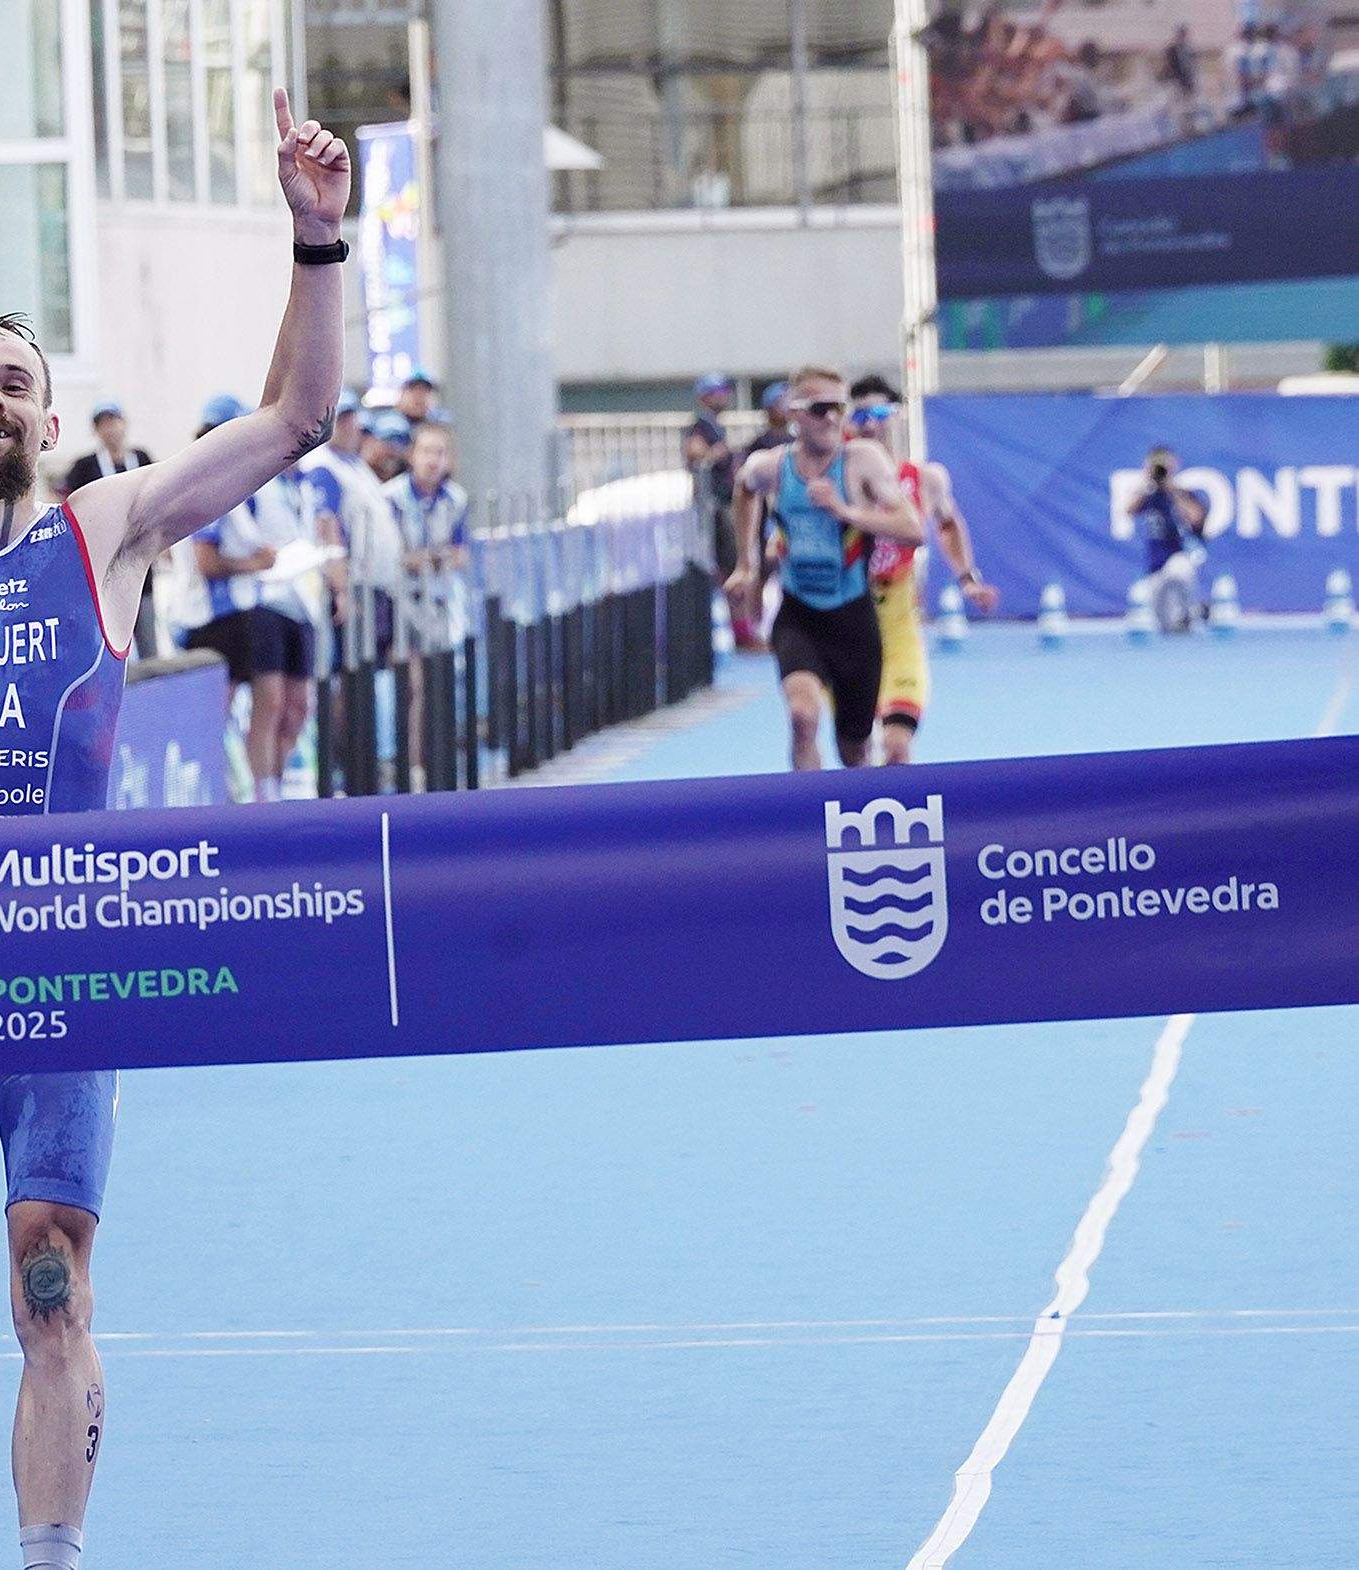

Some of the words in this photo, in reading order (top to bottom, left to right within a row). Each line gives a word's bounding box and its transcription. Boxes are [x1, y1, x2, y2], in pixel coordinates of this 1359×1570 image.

[977, 837, 1157, 880] Concello
[95, 882, 364, 930] Championships
[979, 889, 1033, 926] de
[1042, 876, 1280, 923] Pontevedra
